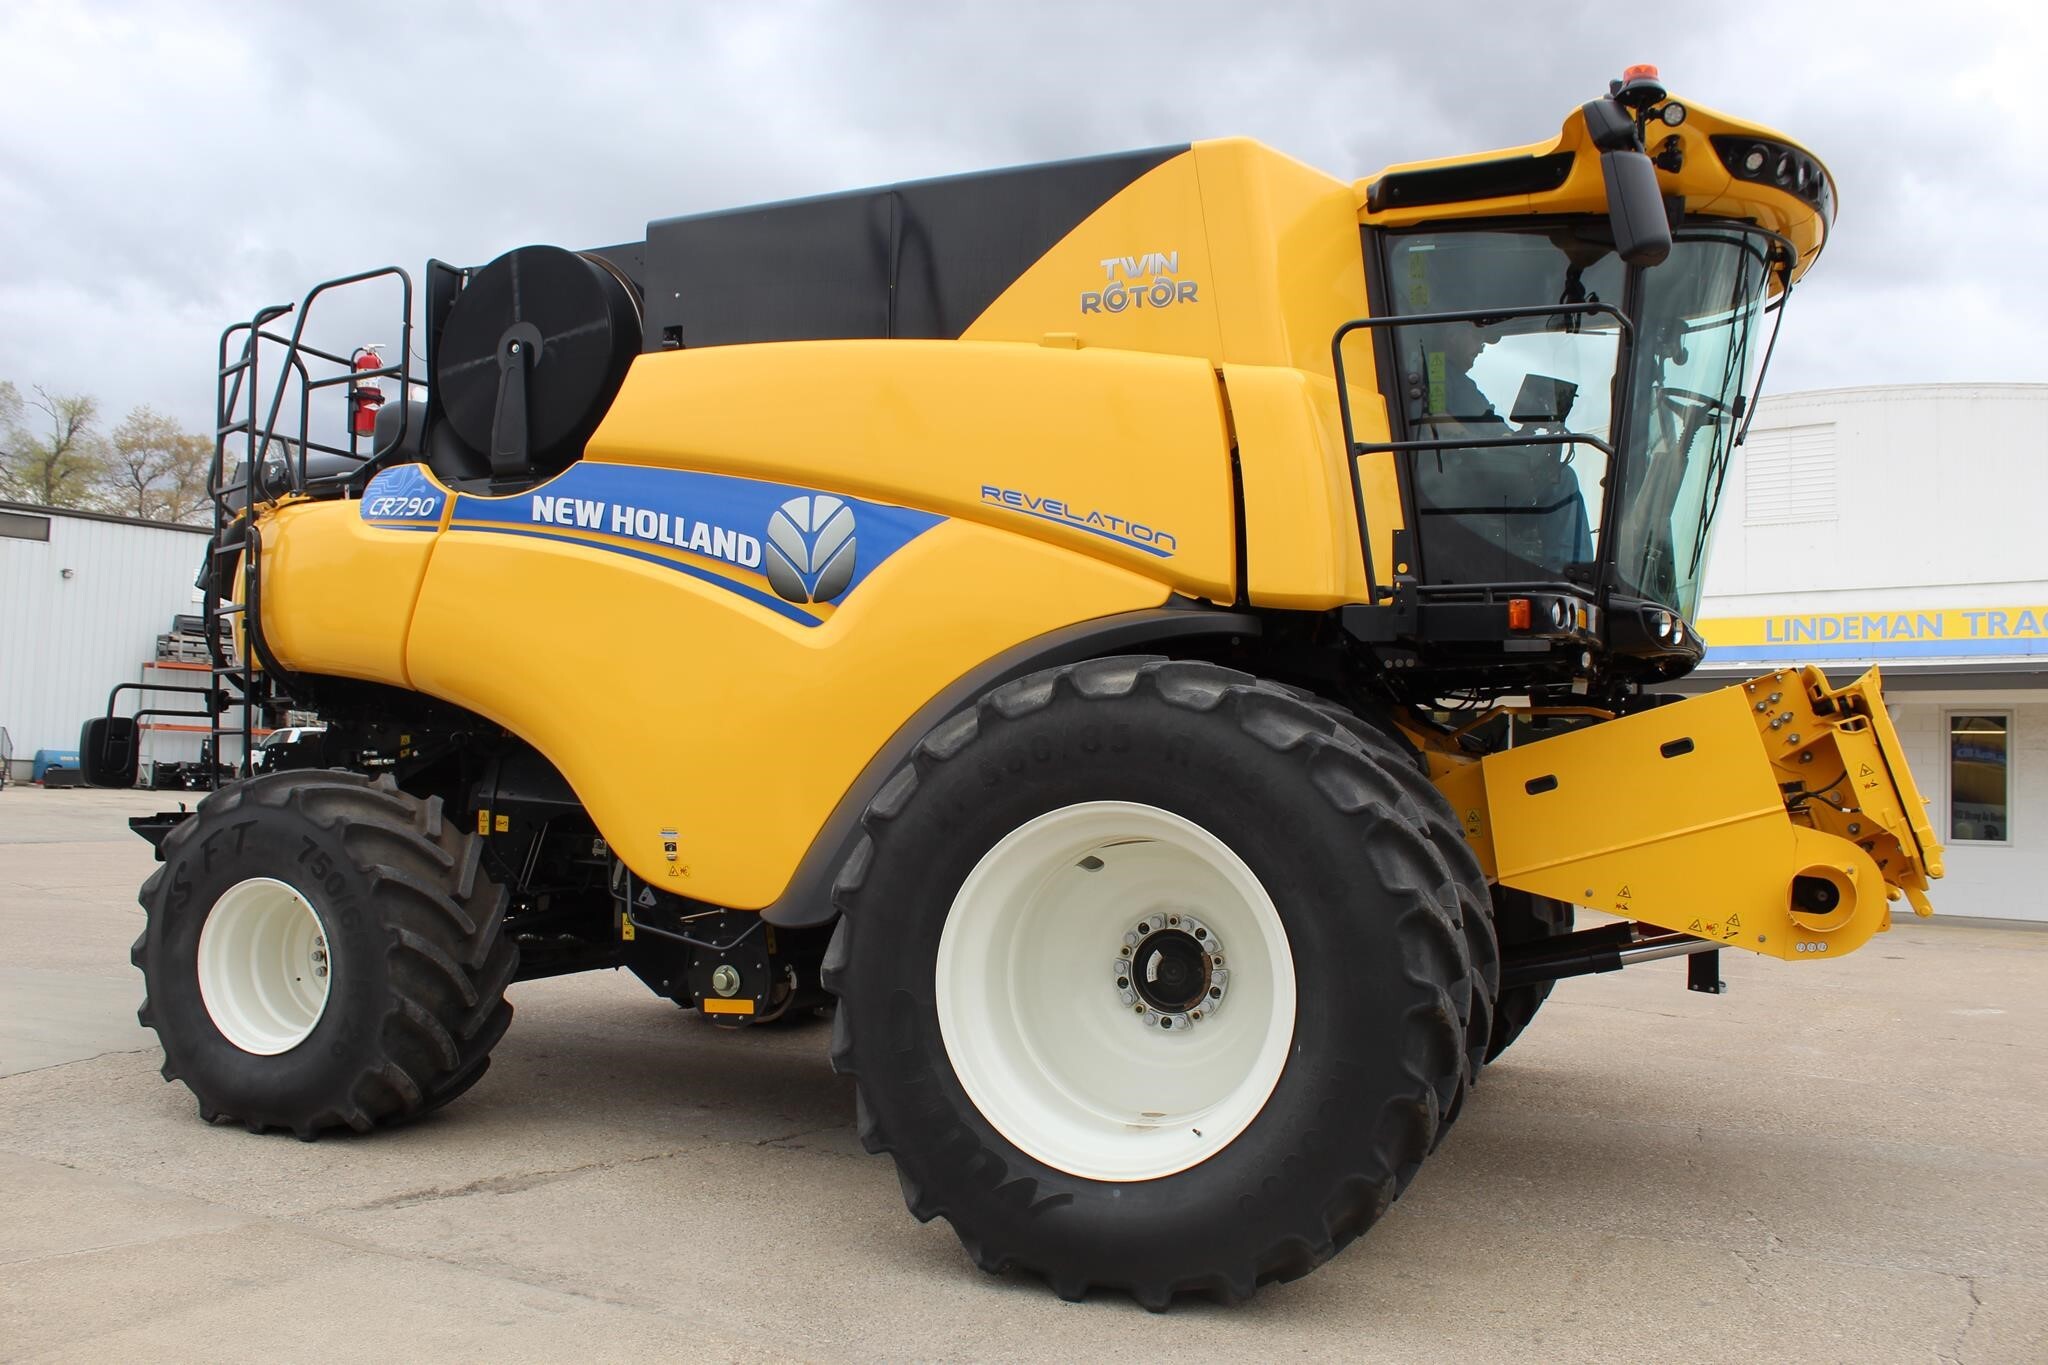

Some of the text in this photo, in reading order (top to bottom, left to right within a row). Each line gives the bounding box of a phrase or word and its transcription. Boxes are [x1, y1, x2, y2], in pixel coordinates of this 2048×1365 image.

[1100, 251, 1179, 281] TWIN
[1081, 276, 1199, 314] ROTOR
[369, 497, 436, 517] CR7.90
[981, 485, 1177, 550] REVELATION
[532, 495, 762, 569] NEW HOLLAND
[1766, 613, 1943, 642] LINDEMAN
